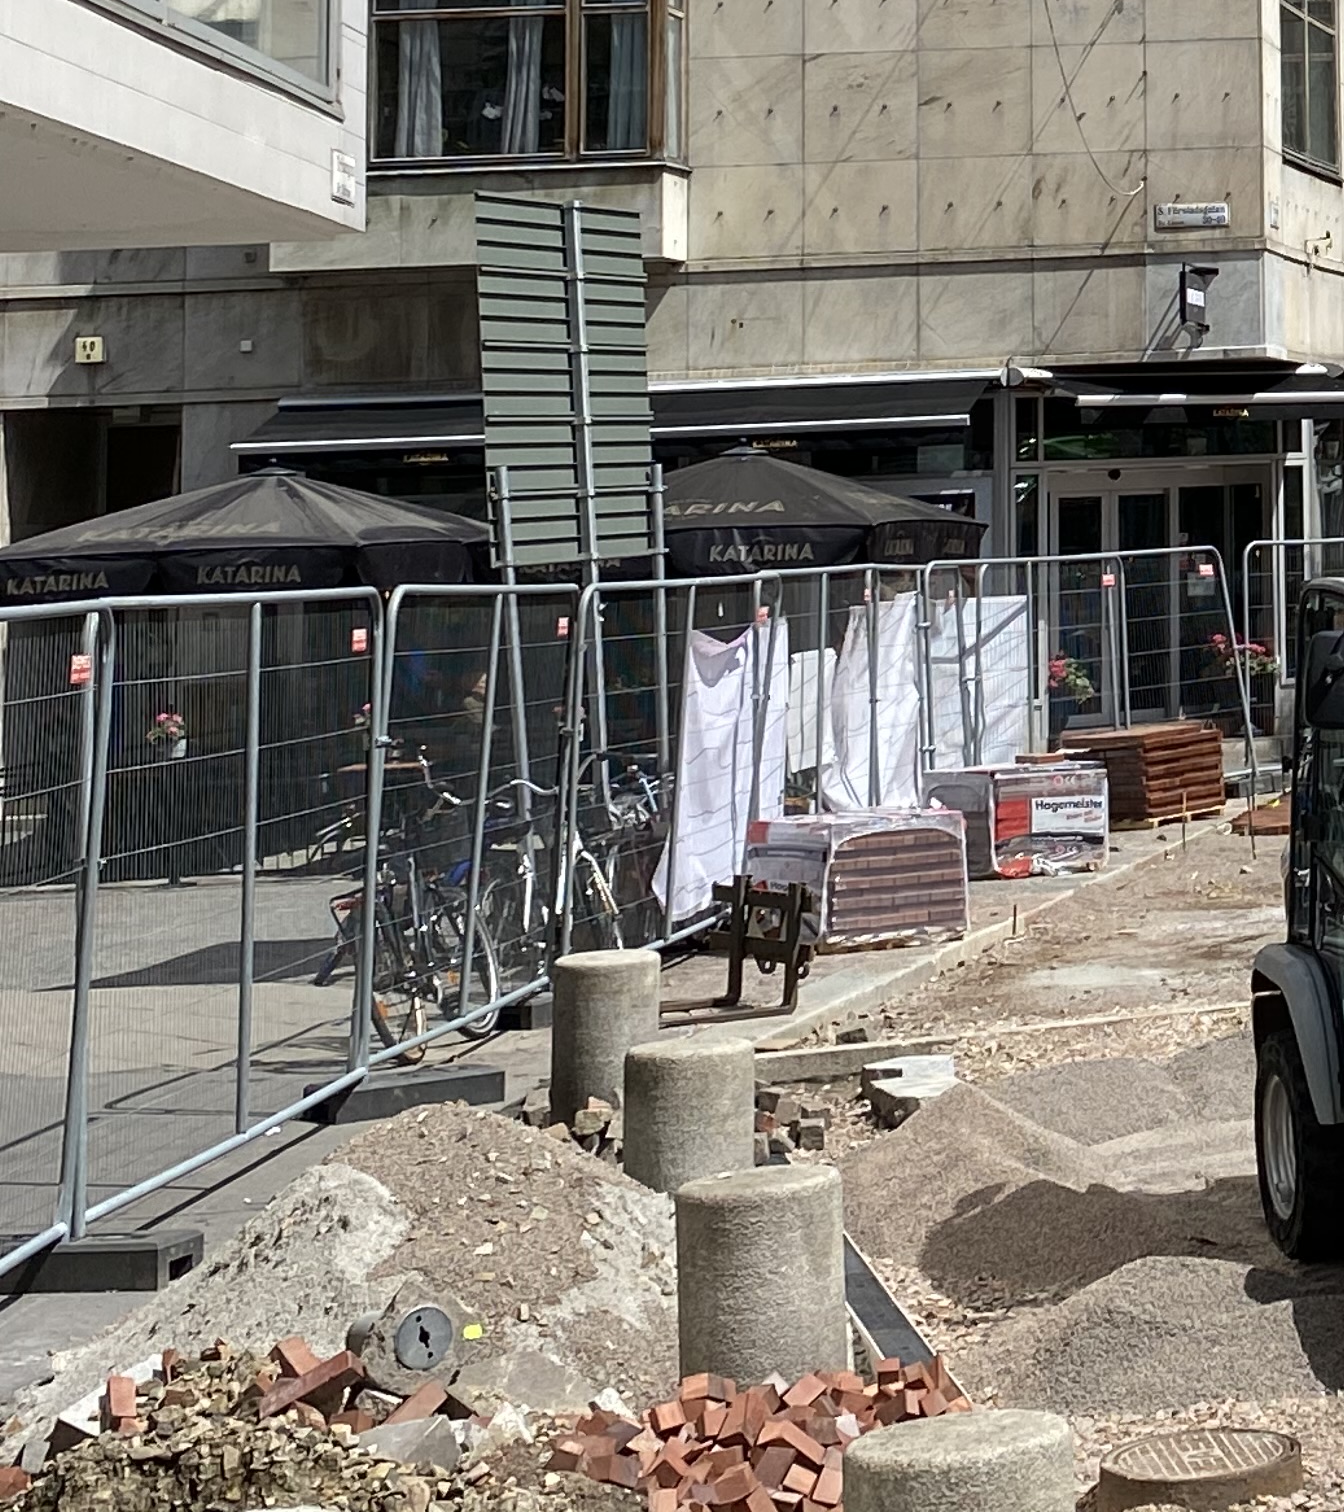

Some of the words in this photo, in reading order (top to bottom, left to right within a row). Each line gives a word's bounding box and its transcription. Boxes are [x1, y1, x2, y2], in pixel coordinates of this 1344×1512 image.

[708, 542, 815, 563] KATARINA
[6, 570, 110, 596] KATARINA
[197, 564, 302, 585] KATARINA
